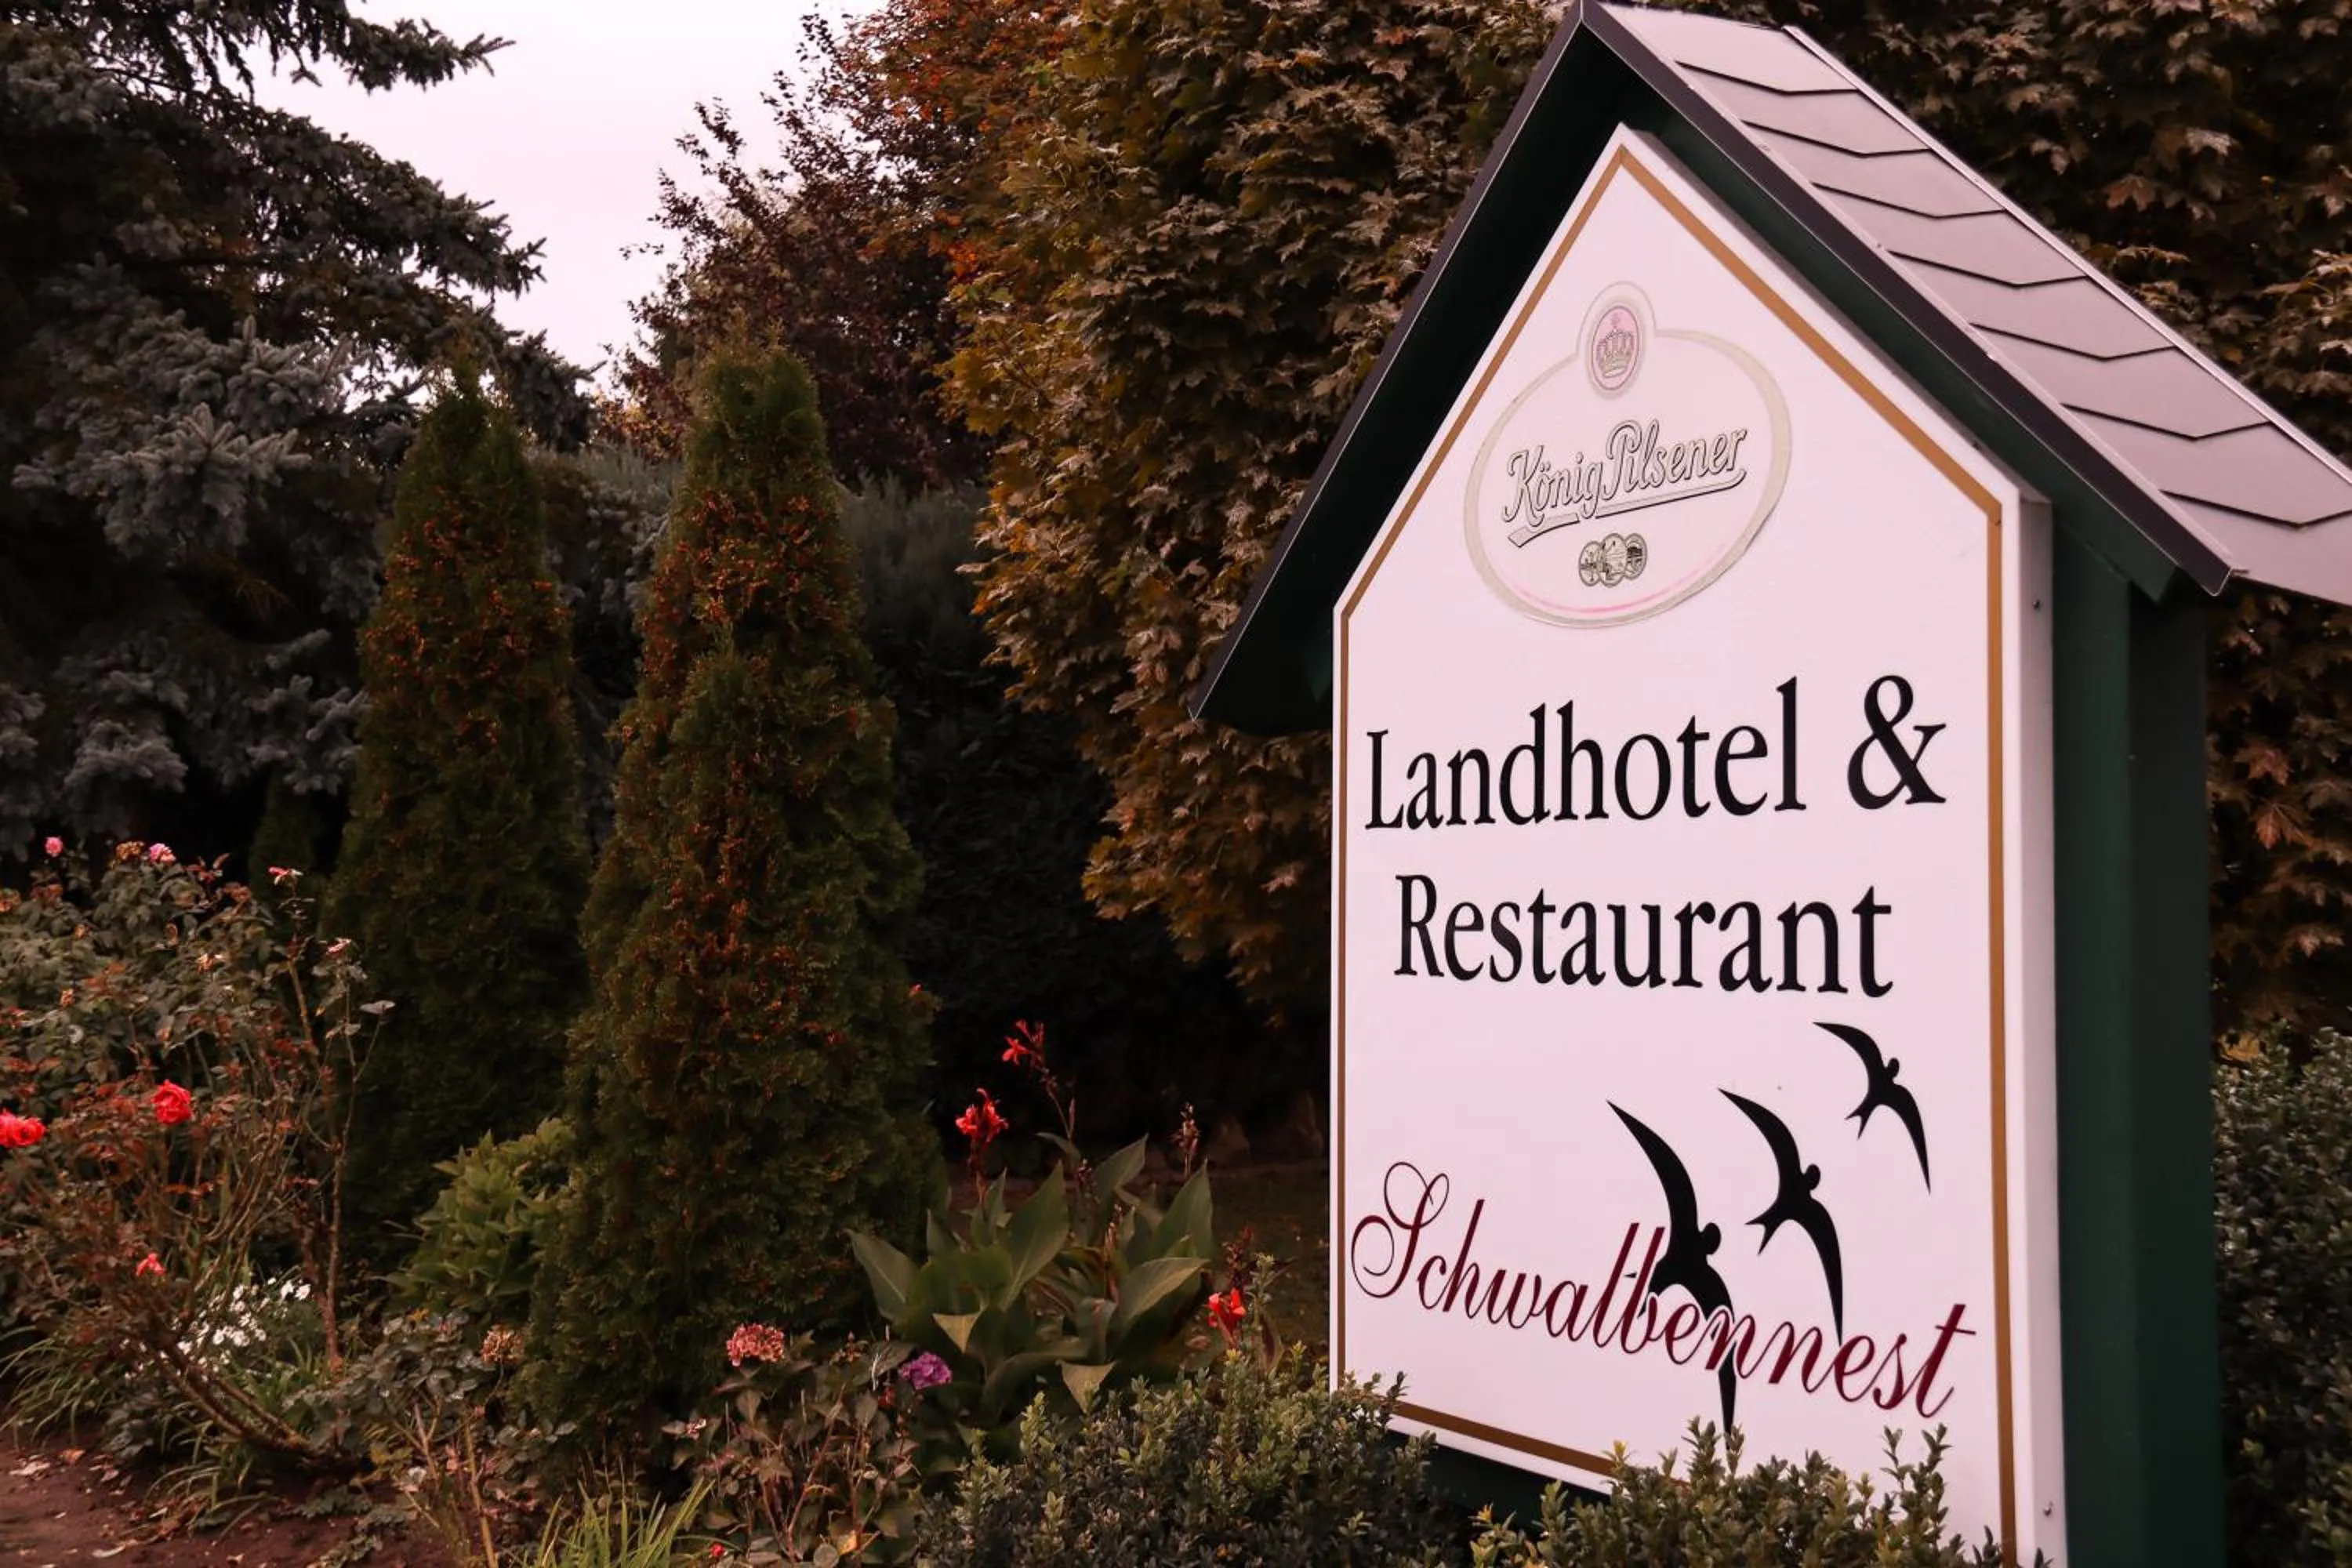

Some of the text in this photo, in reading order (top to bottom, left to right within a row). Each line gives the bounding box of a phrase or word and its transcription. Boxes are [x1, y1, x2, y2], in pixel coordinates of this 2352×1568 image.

[1501, 418, 1748, 528] König Pilsener
[1365, 674, 1947, 830] Landhotel &
[1393, 874, 1893, 998] Restaurant
[1351, 1161, 1977, 1418] Schwalbennest
